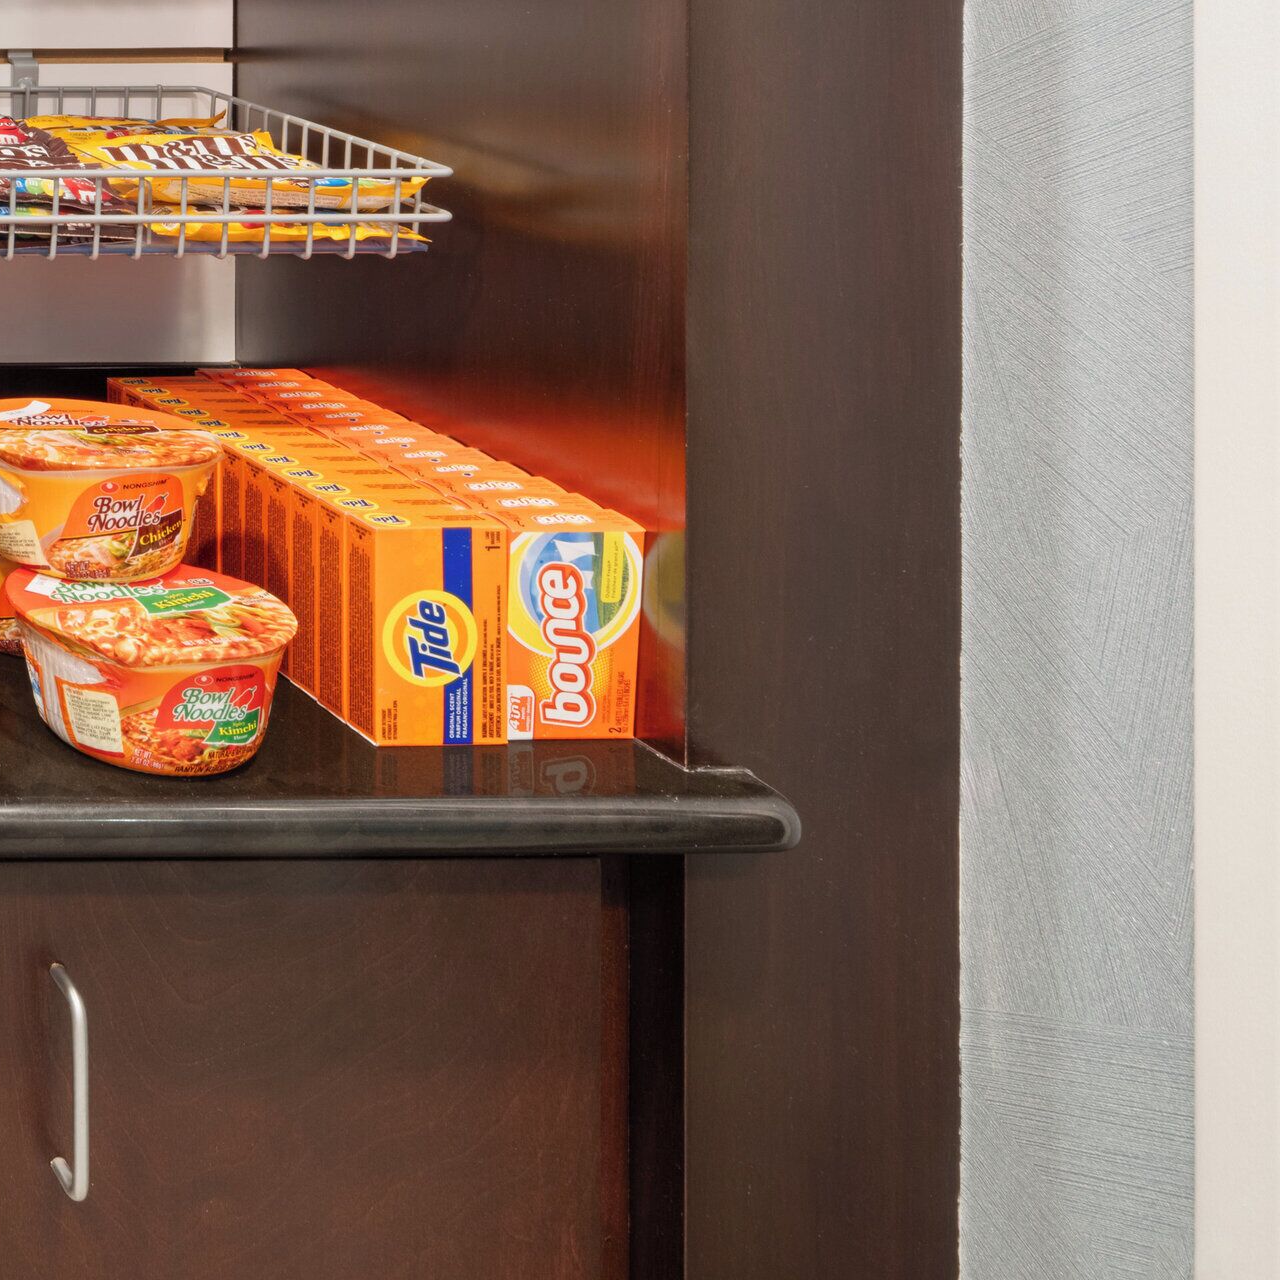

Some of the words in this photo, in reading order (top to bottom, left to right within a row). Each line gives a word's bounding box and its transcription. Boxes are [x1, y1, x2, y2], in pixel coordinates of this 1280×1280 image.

[123, 478, 168, 490] NONGSHIM
[93, 494, 143, 516] Bowl
[87, 509, 162, 533] Noodles
[139, 520, 183, 546] Chicken
[49, 583, 169, 604] Noodles
[153, 590, 215, 610] Kimchi
[407, 598, 463, 680] Tide
[543, 568, 595, 723] bounce
[183, 686, 236, 706] Bowl
[173, 702, 249, 722] Noodles
[218, 719, 258, 737] Kimchi
